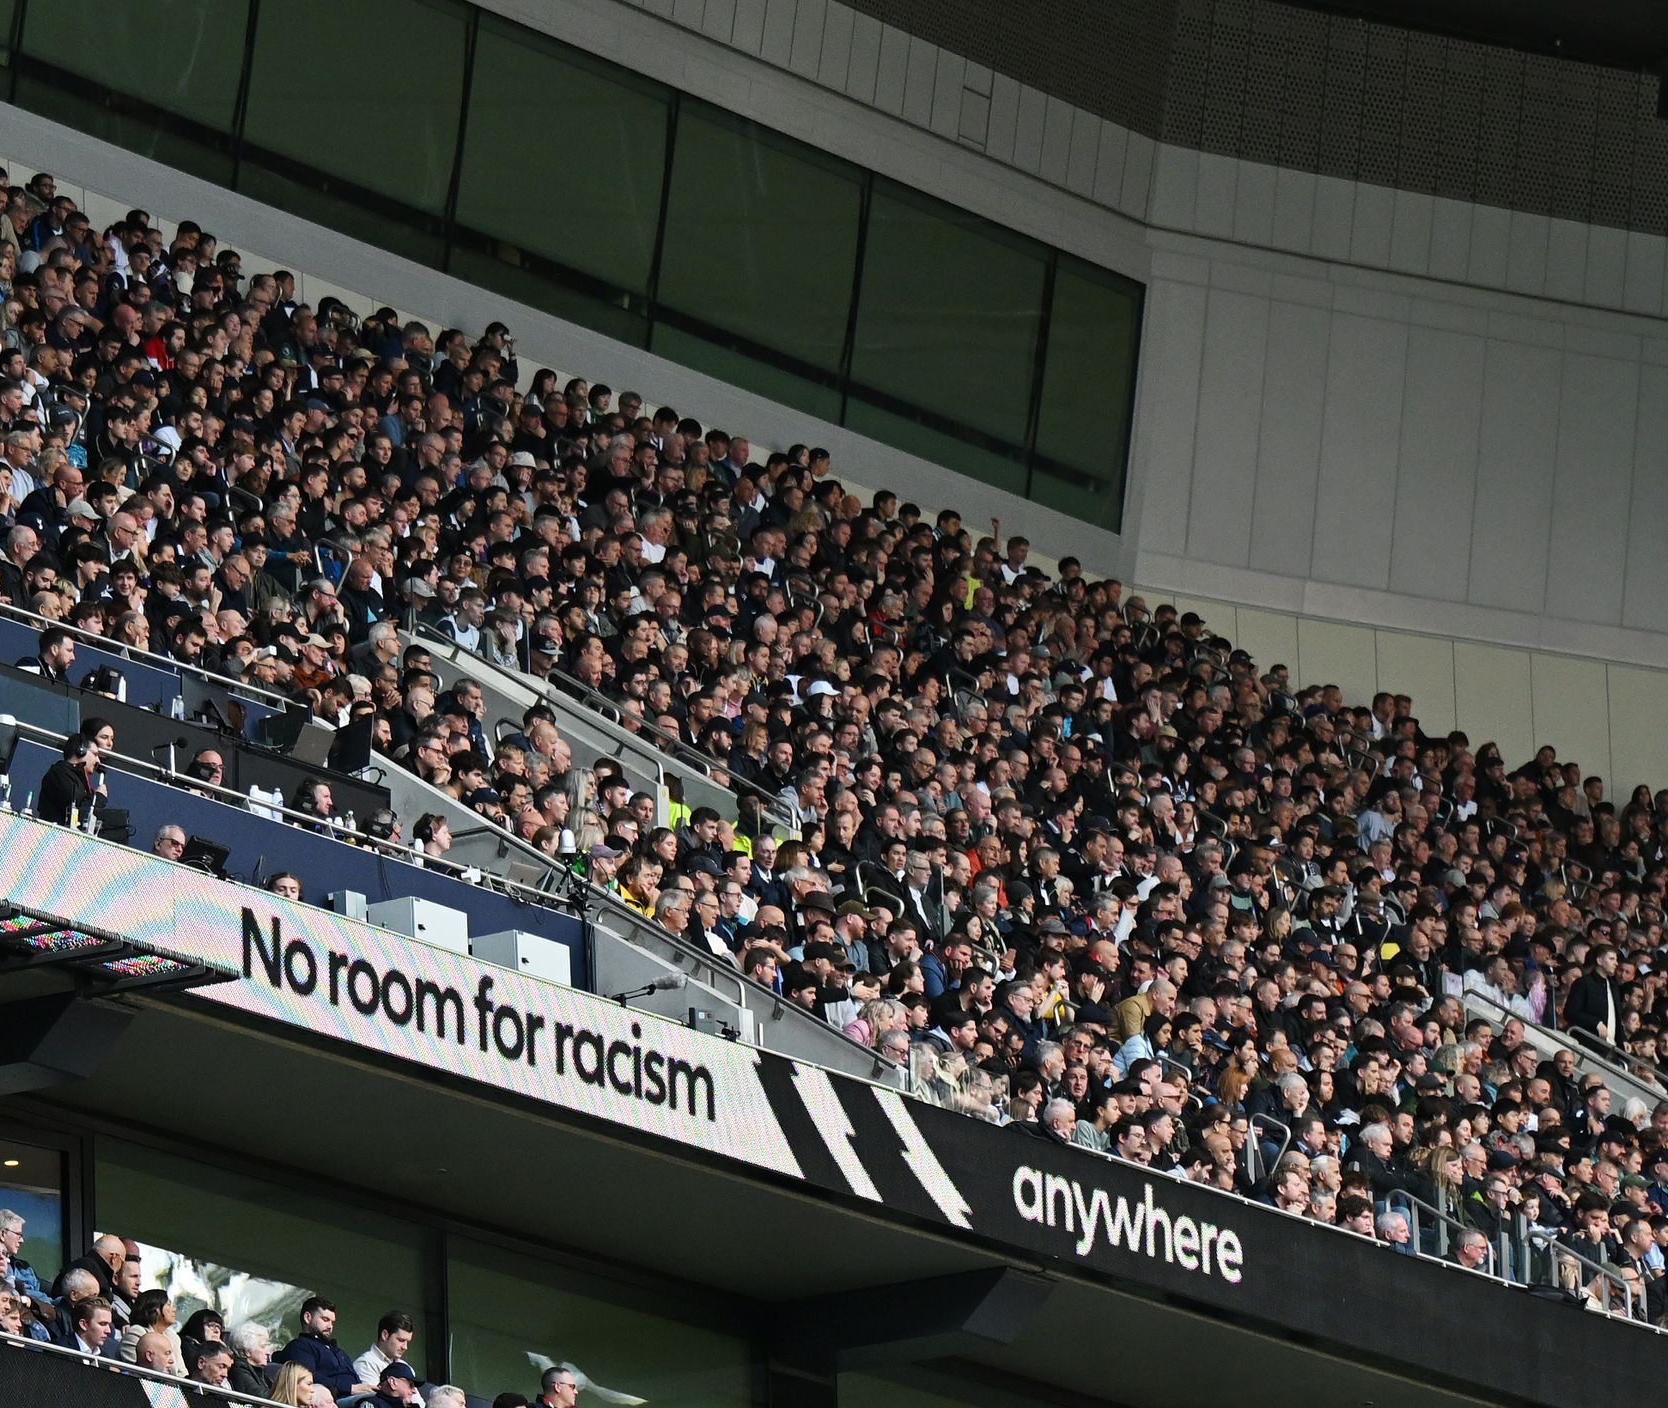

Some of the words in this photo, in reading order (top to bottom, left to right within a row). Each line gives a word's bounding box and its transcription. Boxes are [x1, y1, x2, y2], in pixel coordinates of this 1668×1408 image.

[242, 907, 317, 995] No
[329, 957, 466, 1044] room
[473, 977, 545, 1065] for
[556, 1023, 716, 1121] racism
[1013, 1164, 1243, 1283] anywhere
